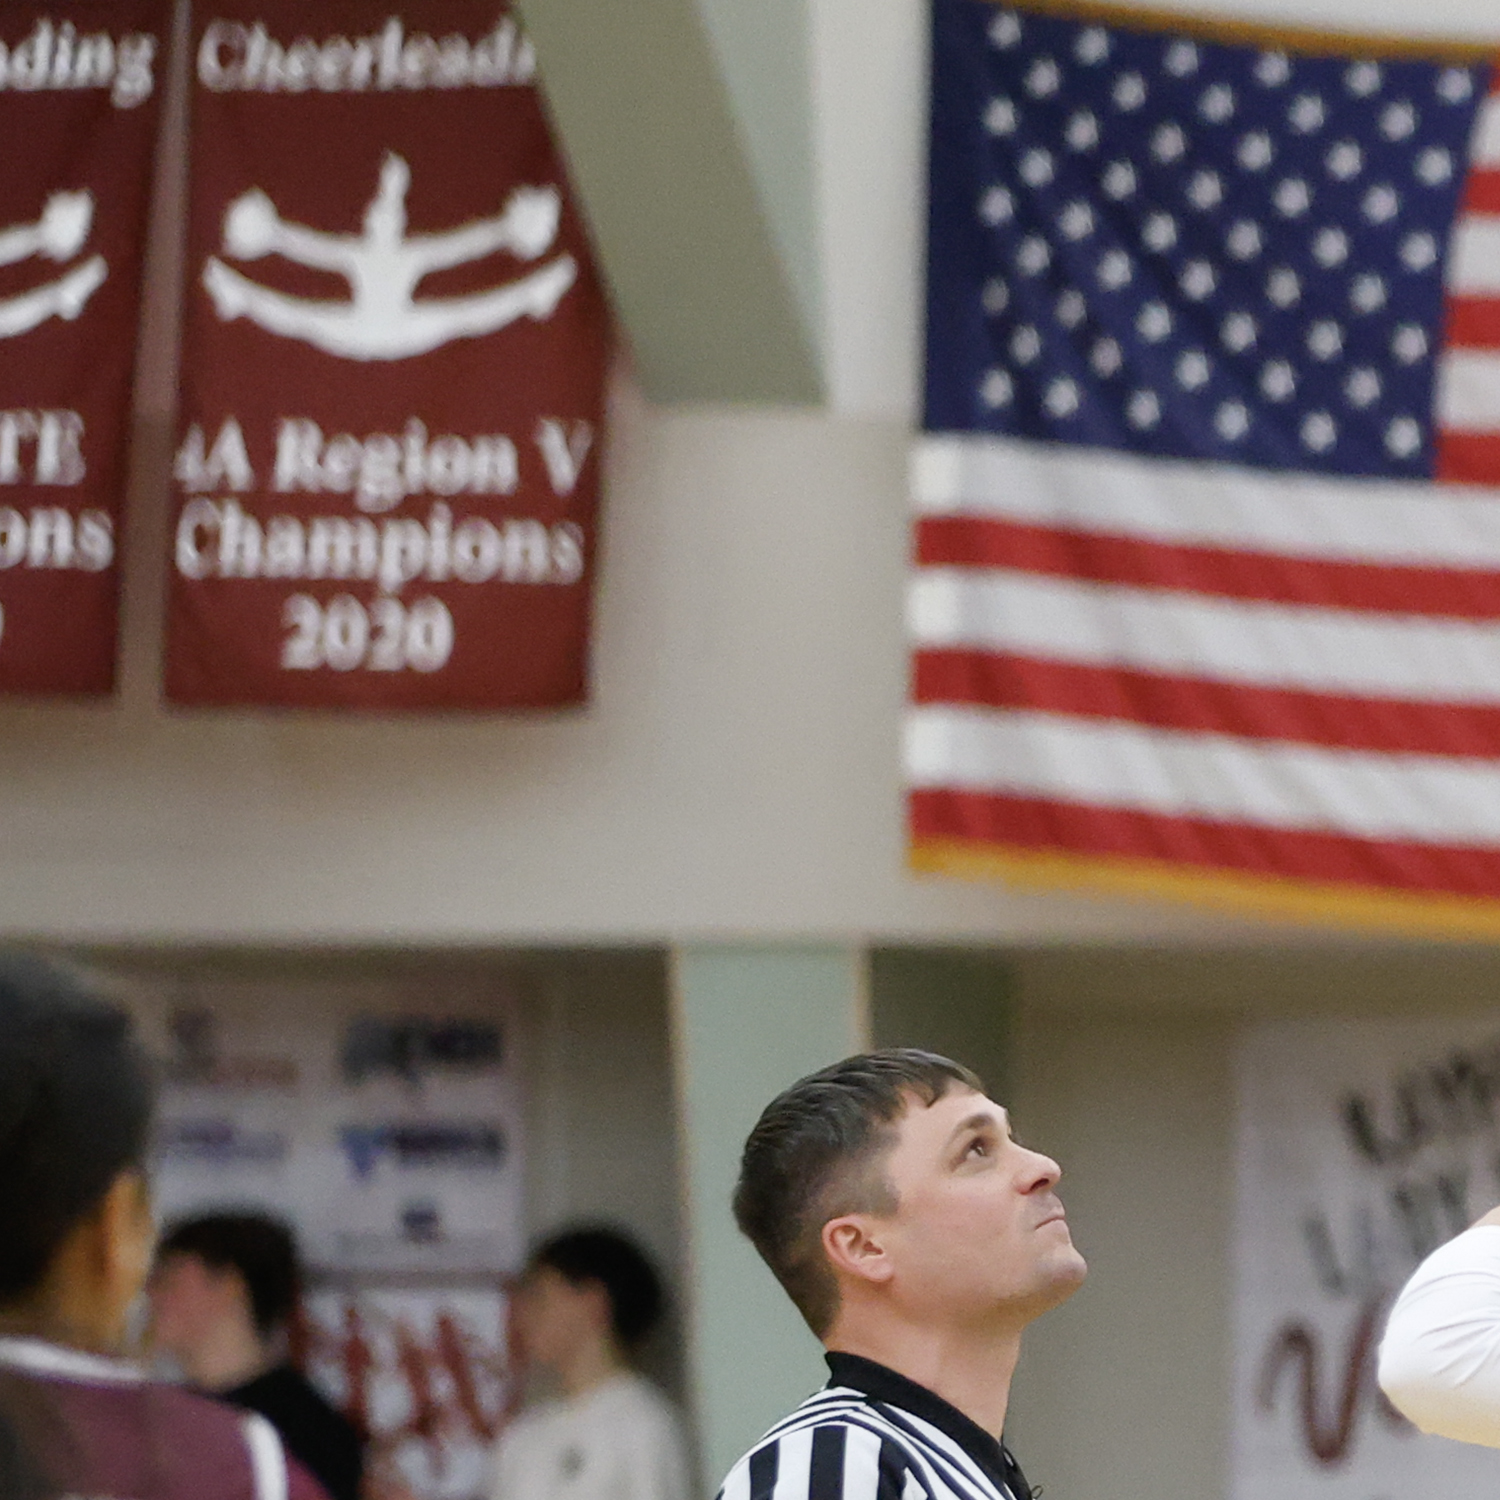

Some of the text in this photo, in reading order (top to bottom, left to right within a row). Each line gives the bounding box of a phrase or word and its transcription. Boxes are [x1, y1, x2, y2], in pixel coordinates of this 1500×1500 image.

[0, 18, 156, 108] ding
[275, 416, 519, 512] Region
[536, 418, 592, 495] V
[176, 497, 584, 592] Champions
[281, 593, 454, 672] 2020
